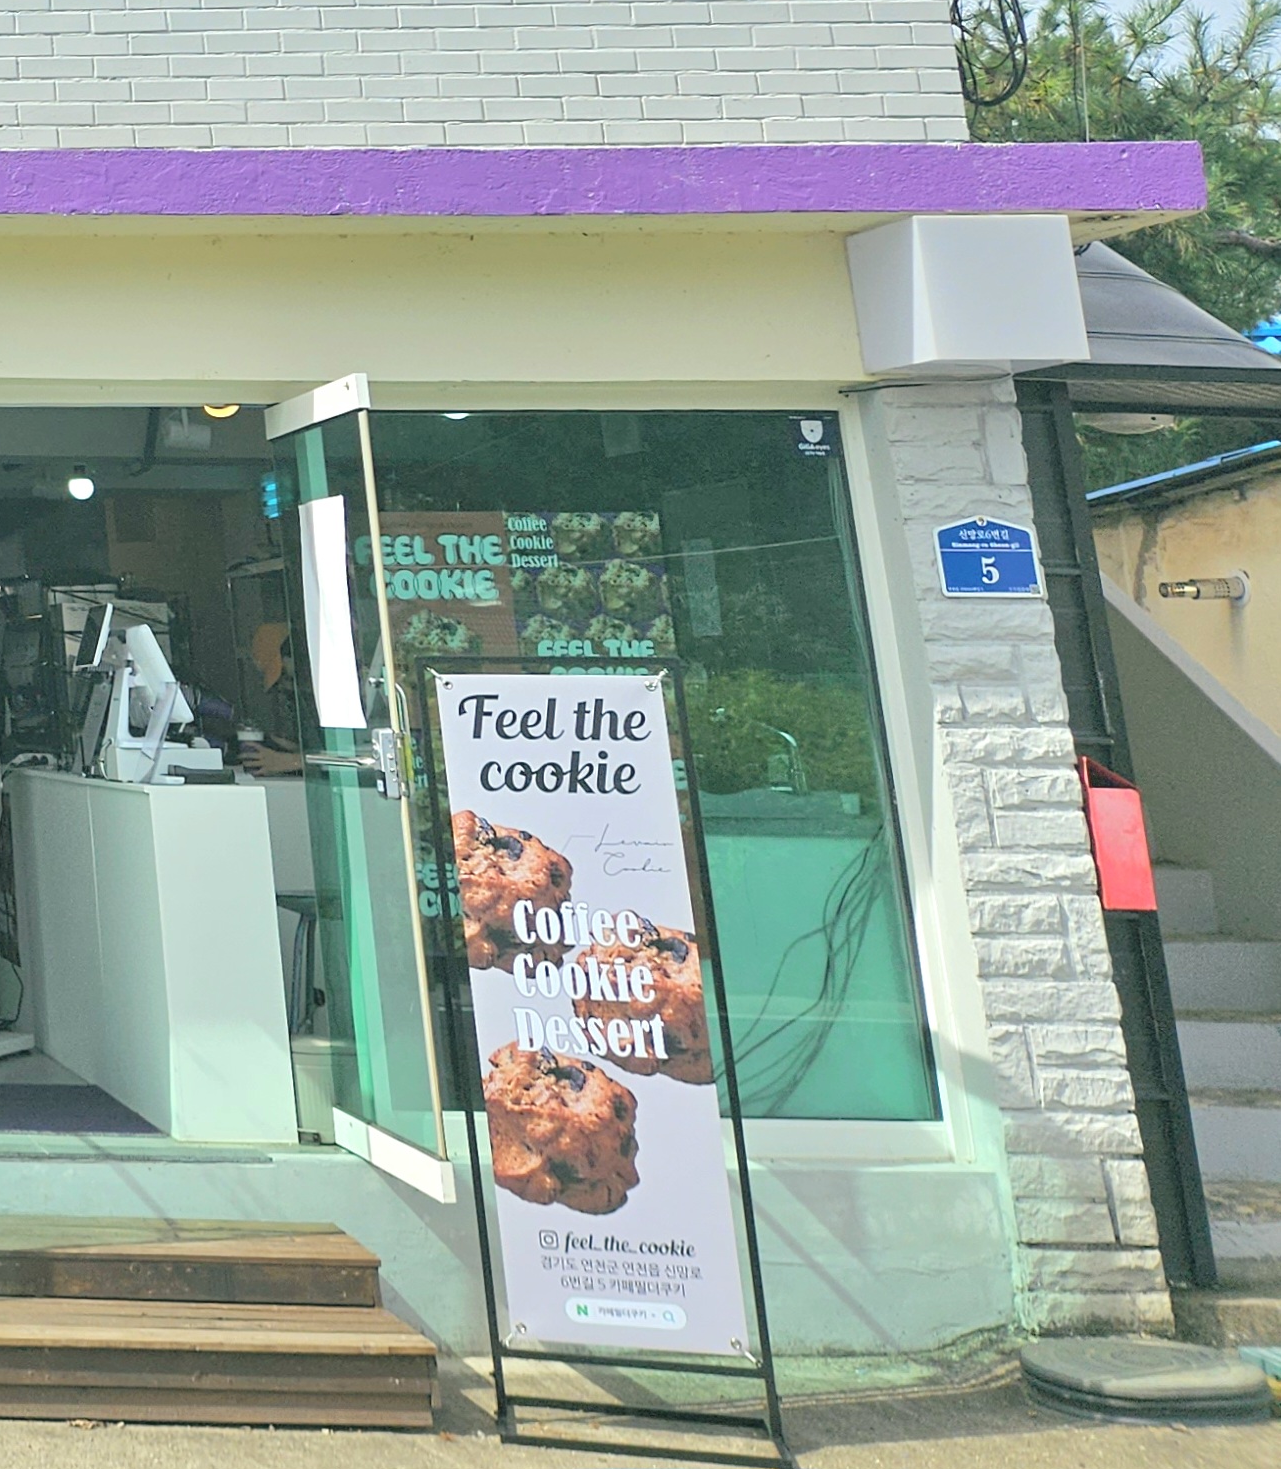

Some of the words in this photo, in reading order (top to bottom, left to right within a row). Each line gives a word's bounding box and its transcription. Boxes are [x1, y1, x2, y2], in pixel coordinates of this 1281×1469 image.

[507, 516, 548, 532] Coffee
[354, 534, 435, 566] FEEL
[437, 533, 507, 566] THE
[509, 535, 555, 551] Cookie
[511, 552, 559, 569] Dessert
[980, 556, 1000, 584] 5
[458, 694, 565, 741] Feel
[573, 698, 652, 741] the
[480, 750, 642, 795] cookie
[513, 899, 641, 948] Coffee
[513, 952, 656, 1003] Cookie
[512, 1007, 669, 1059] Dessert
[564, 1230, 696, 1258] feel_the_cookie
[540, 1255, 578, 1271] 경기도
[580, 1258, 619, 1275] 연천군
[621, 1260, 660, 1278] 연천읍
[560, 1275, 594, 1290] 6번길
[598, 1278, 606, 1291] 5
